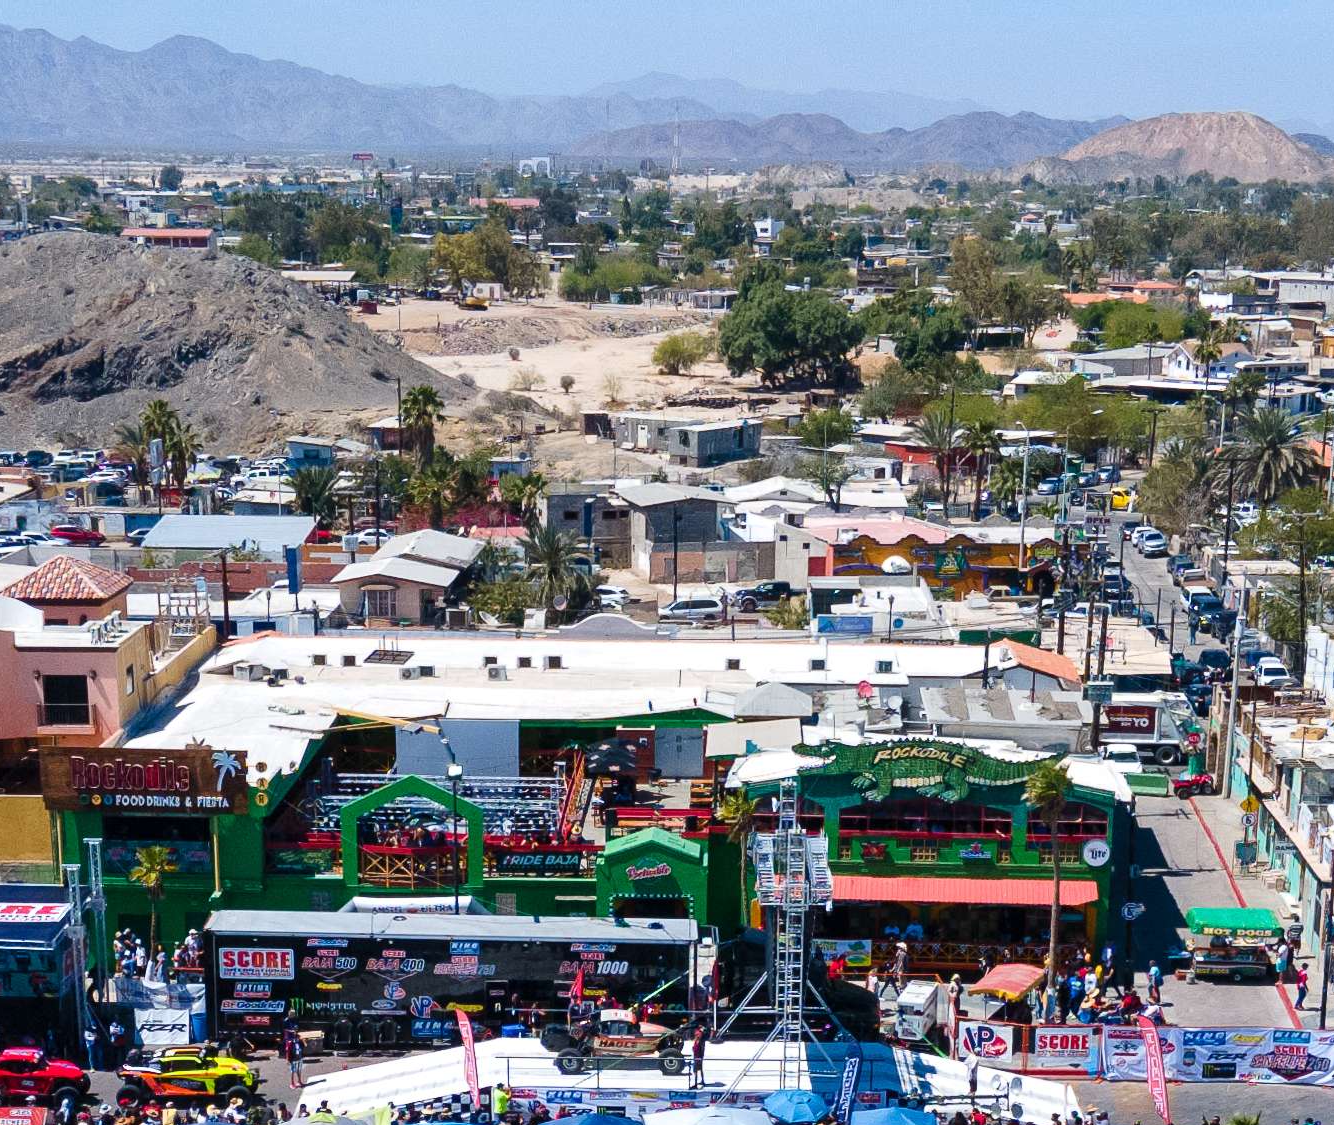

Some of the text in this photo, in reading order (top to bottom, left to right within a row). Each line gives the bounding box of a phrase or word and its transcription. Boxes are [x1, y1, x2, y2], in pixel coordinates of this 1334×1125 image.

[873, 747, 967, 768] ROCKODILE
[70, 755, 191, 792] Rockodile
[115, 797, 145, 806] FOOD
[146, 797, 181, 807] DRINKS
[546, 855, 579, 865] BAJA
[1203, 927, 1272, 936] HOT DOGS
[223, 951, 290, 968] SCORE
[335, 957, 357, 969] 500
[400, 959, 424, 971] 400
[597, 962, 629, 974] 1000
[222, 1000, 284, 1011] BFGoodrich
[138, 1024, 187, 1032] RZR
[1038, 1034, 1089, 1050] SCORE
